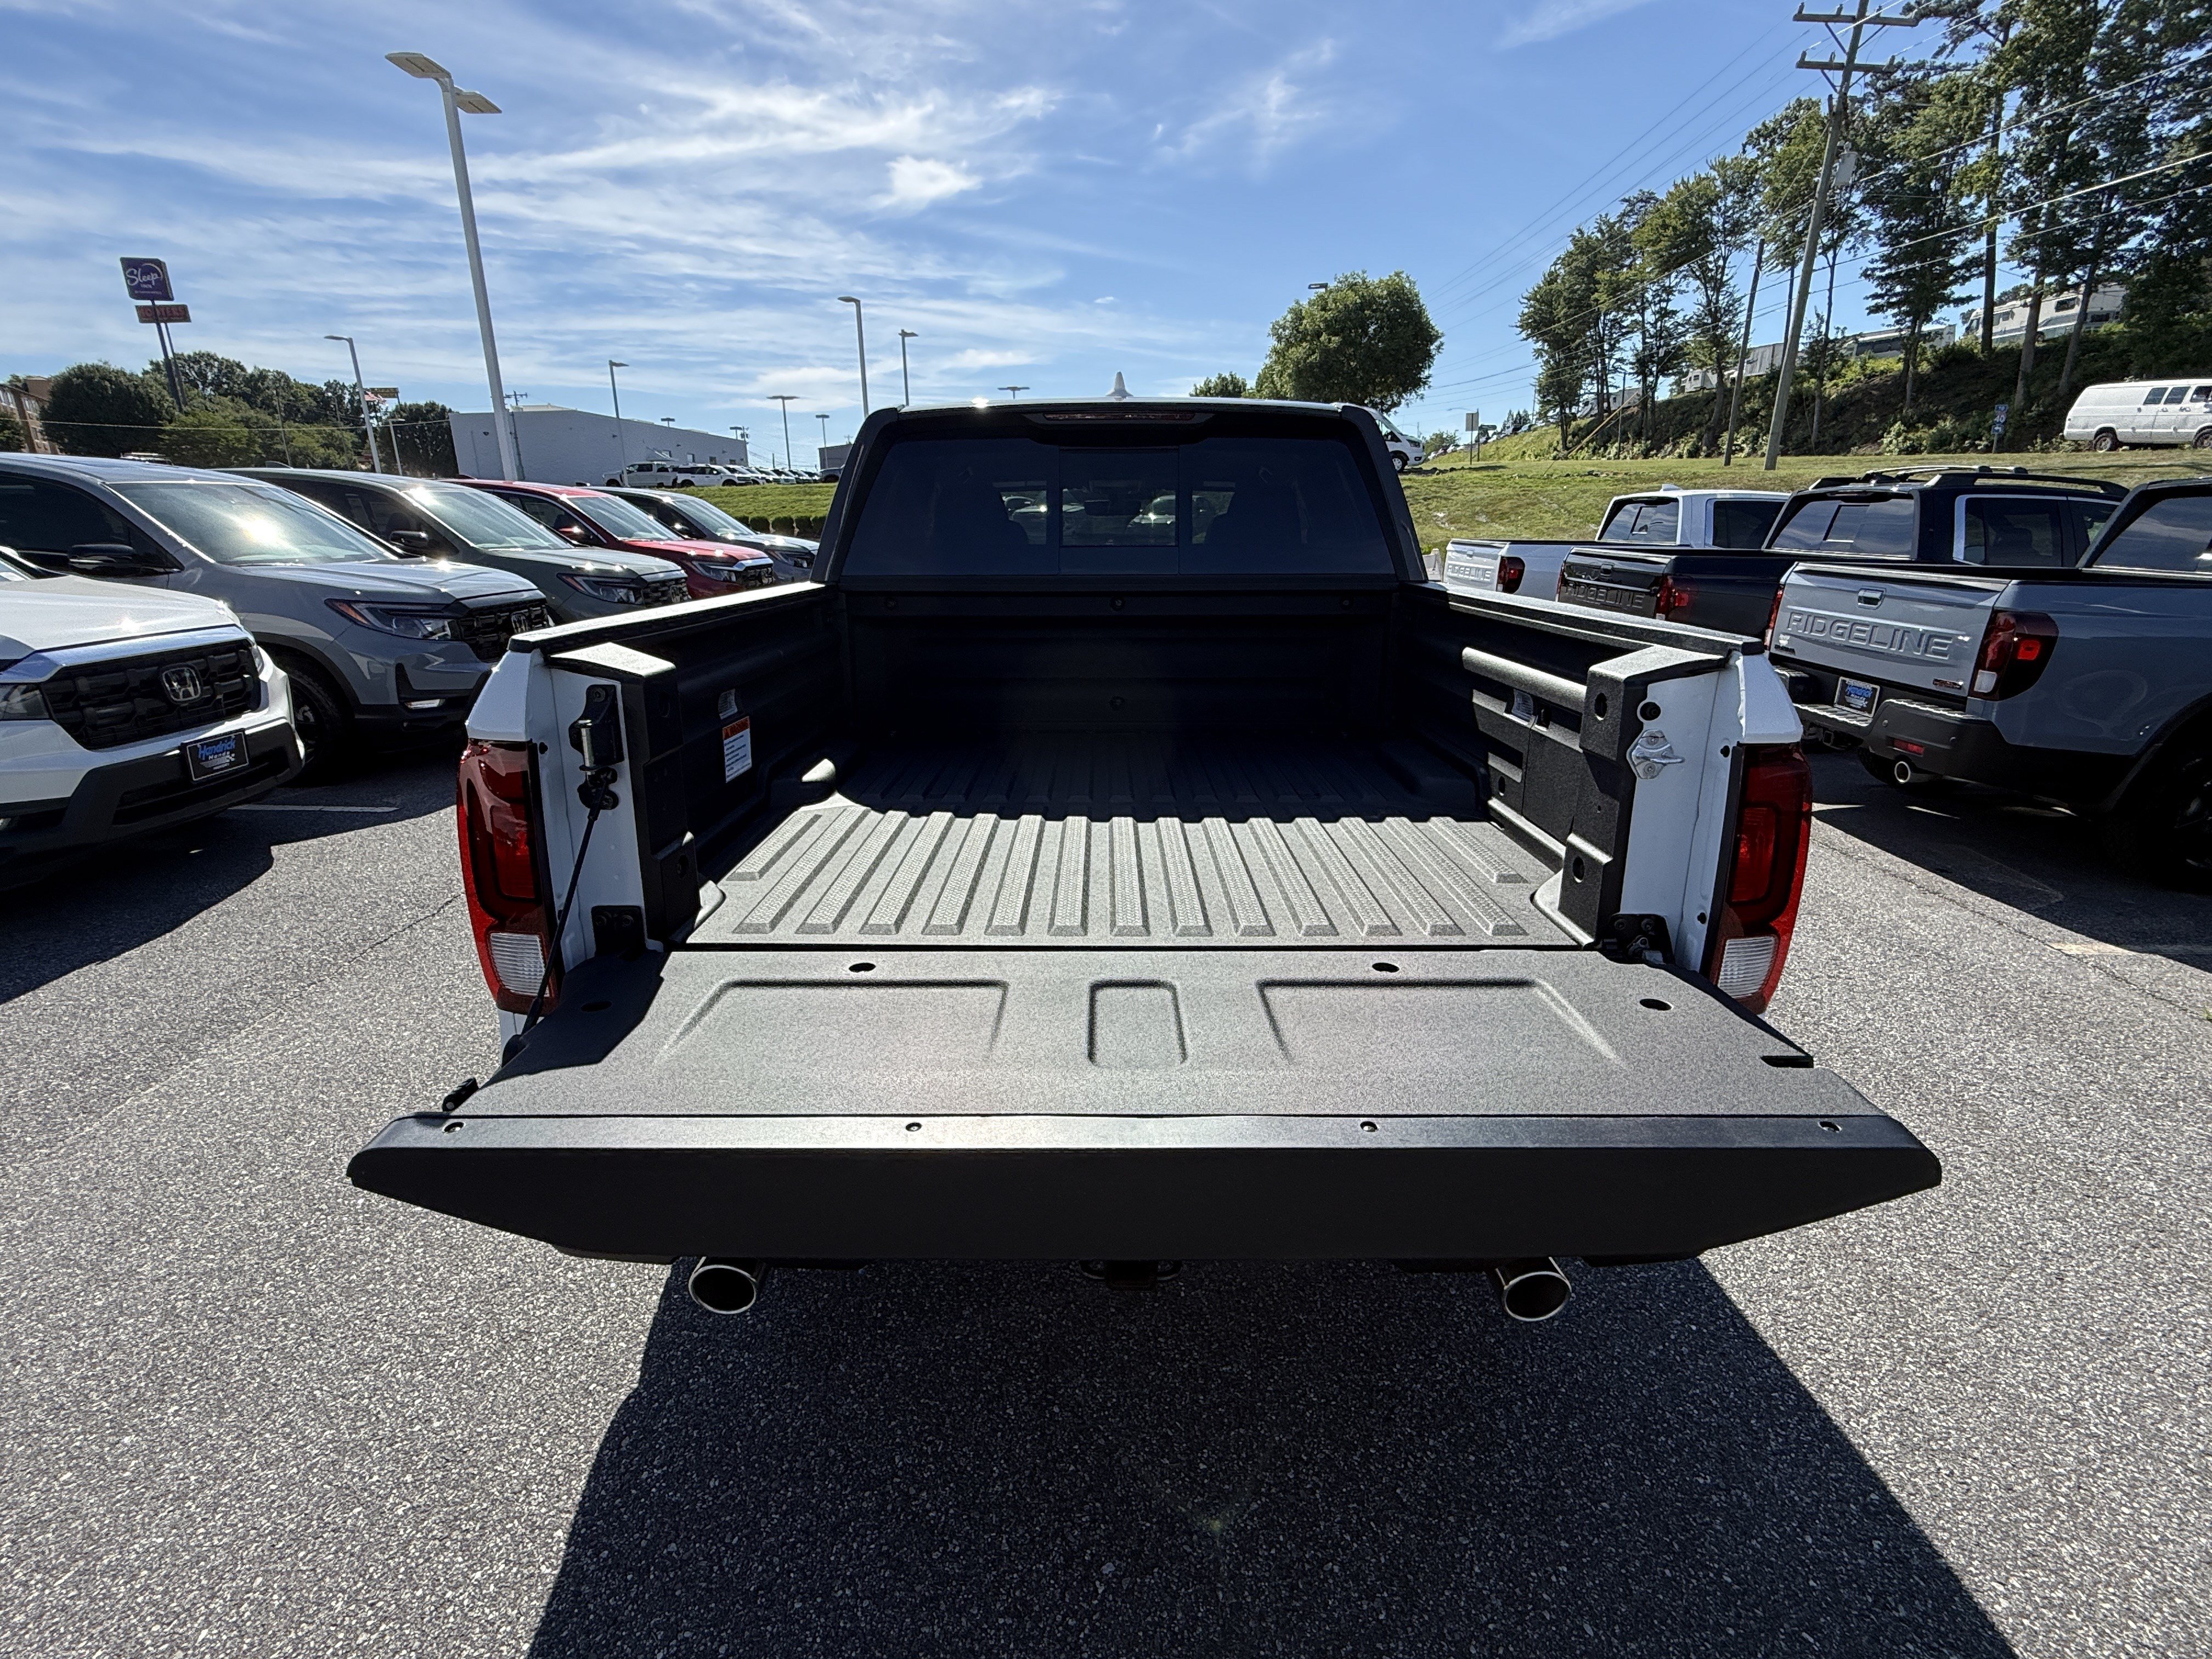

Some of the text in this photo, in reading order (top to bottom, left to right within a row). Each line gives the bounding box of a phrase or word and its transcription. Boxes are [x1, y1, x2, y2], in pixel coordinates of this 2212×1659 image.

[126, 268, 160, 286] Sleep
[1994, 415, 2006, 423] 40
[1447, 565, 1492, 582] RIDGELINE
[1565, 580, 1645, 609] RIDGELINE
[1787, 611, 1953, 660] RIDGELINE
